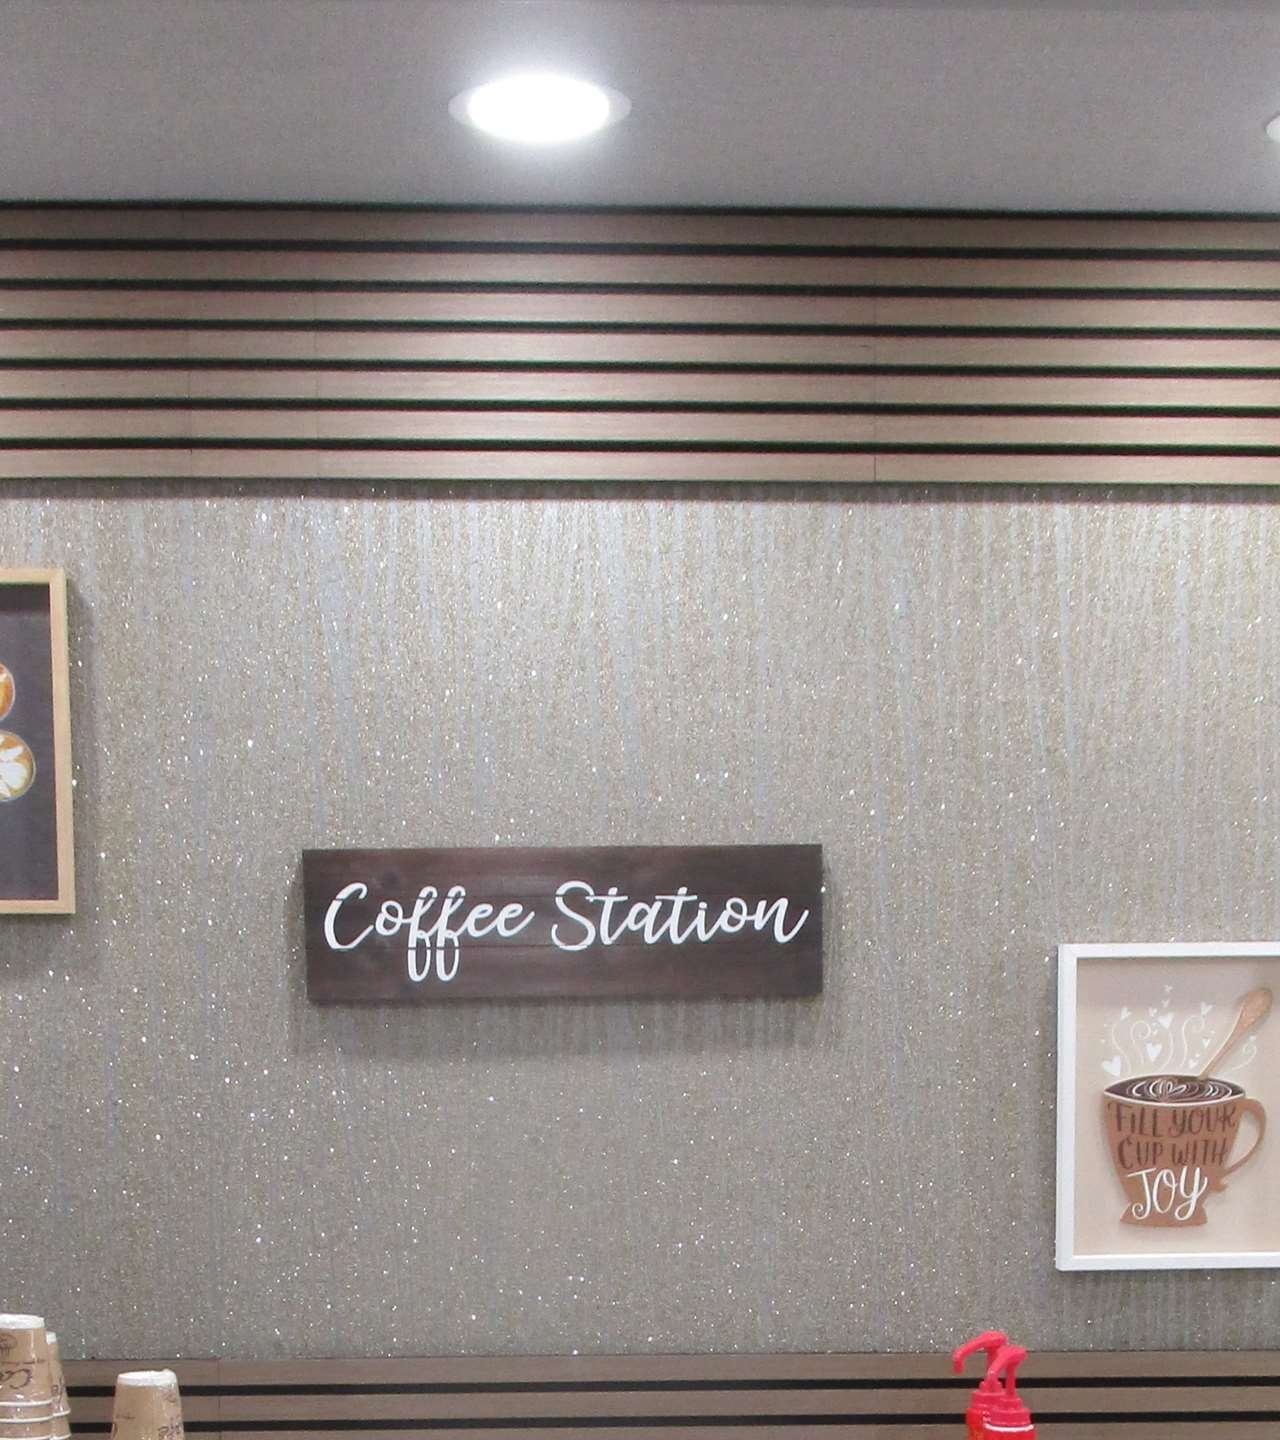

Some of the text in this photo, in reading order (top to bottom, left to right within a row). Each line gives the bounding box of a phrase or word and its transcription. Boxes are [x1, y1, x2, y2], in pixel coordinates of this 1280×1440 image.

[324, 880, 809, 982] Coffee Station
[1118, 1136, 1228, 1170] CUP WITH
[1127, 1165, 1208, 1220] JOY
